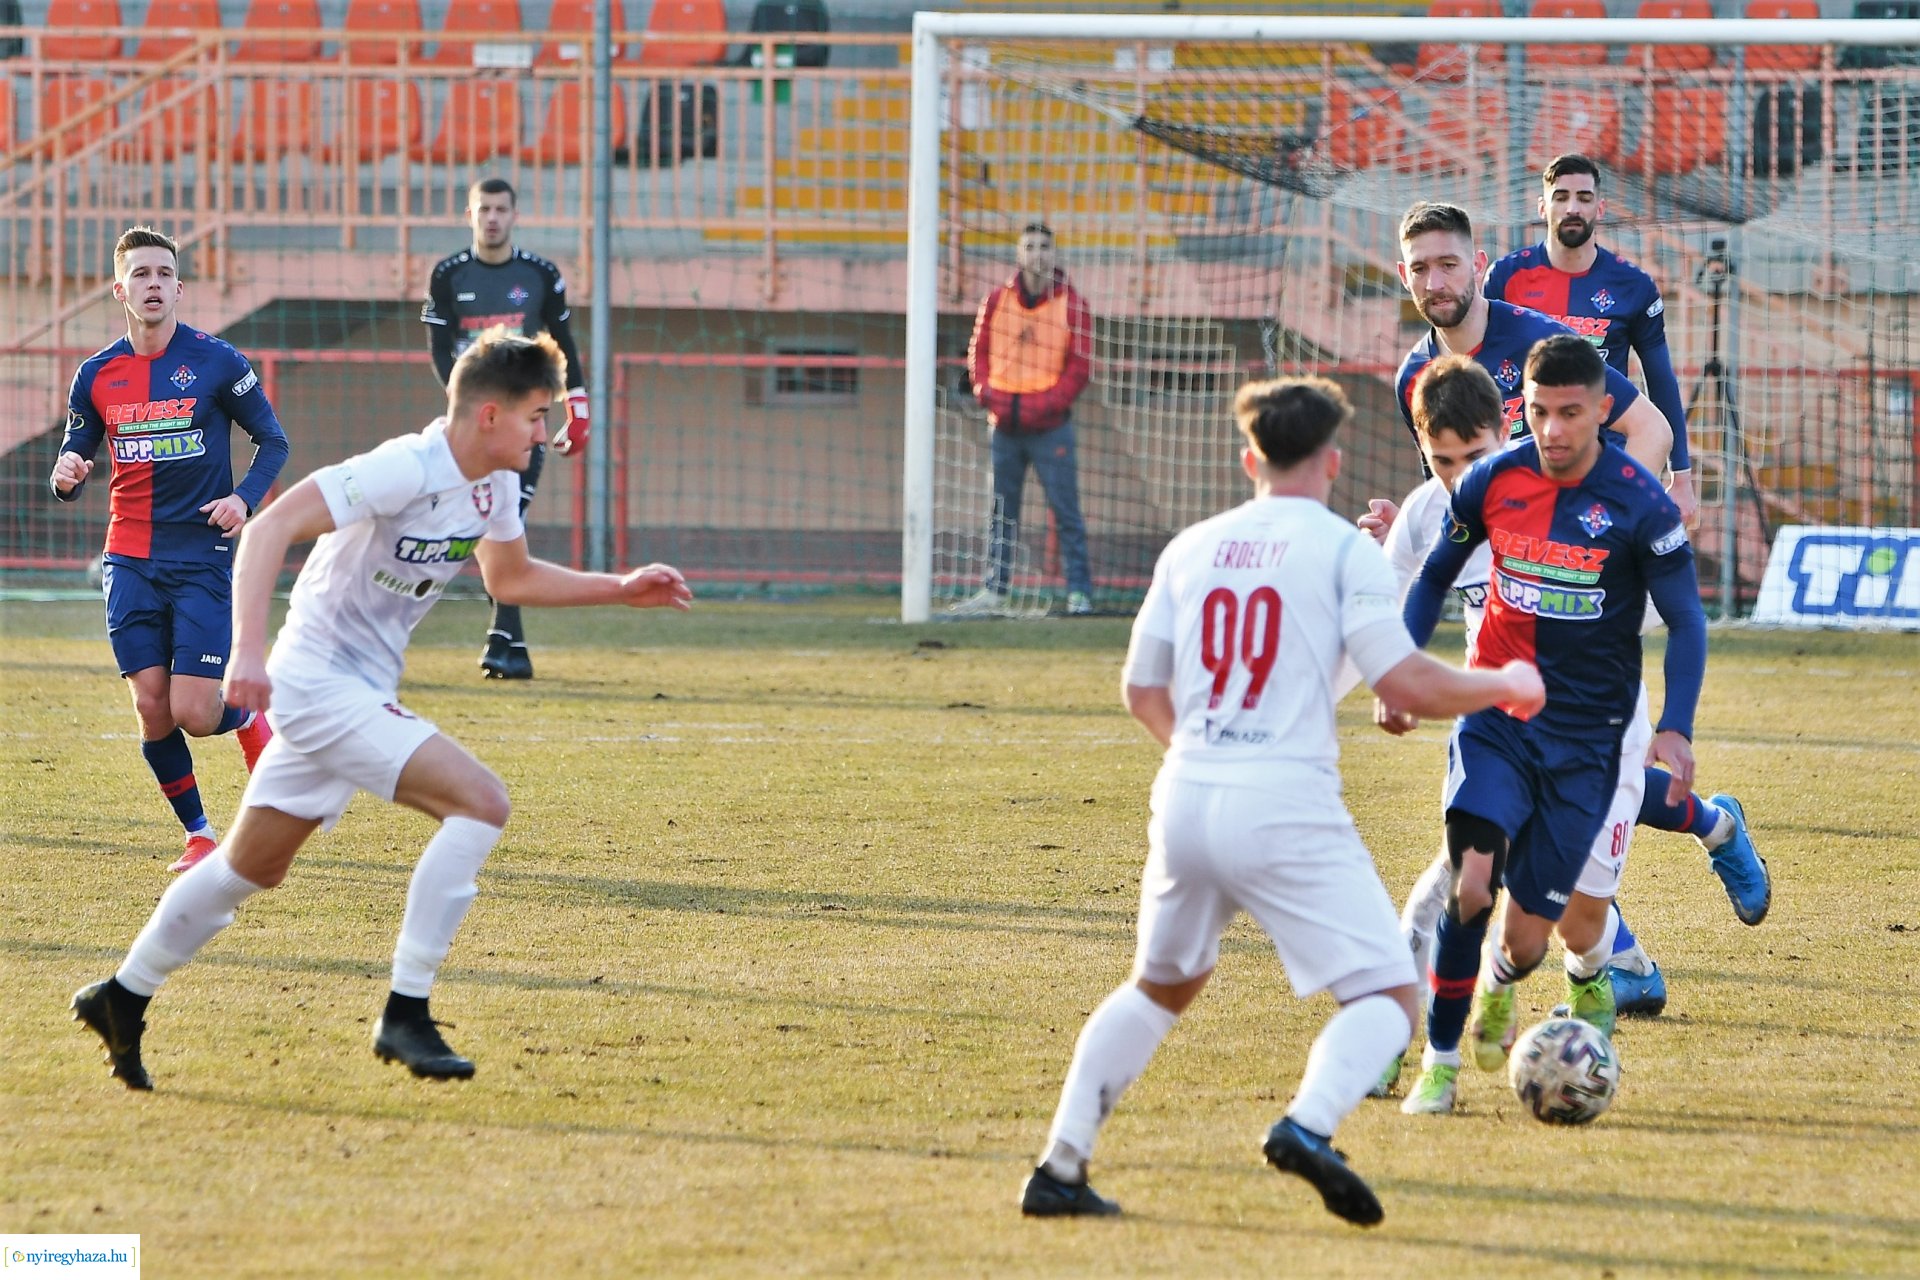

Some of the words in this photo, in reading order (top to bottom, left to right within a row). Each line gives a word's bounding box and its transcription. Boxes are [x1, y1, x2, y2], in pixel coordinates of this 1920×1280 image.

[106, 398, 197, 425] REVESZ
[1492, 527, 1610, 572] REVESZ
[200, 654, 222, 665] JAKO
[1202, 586, 1282, 710] 99
